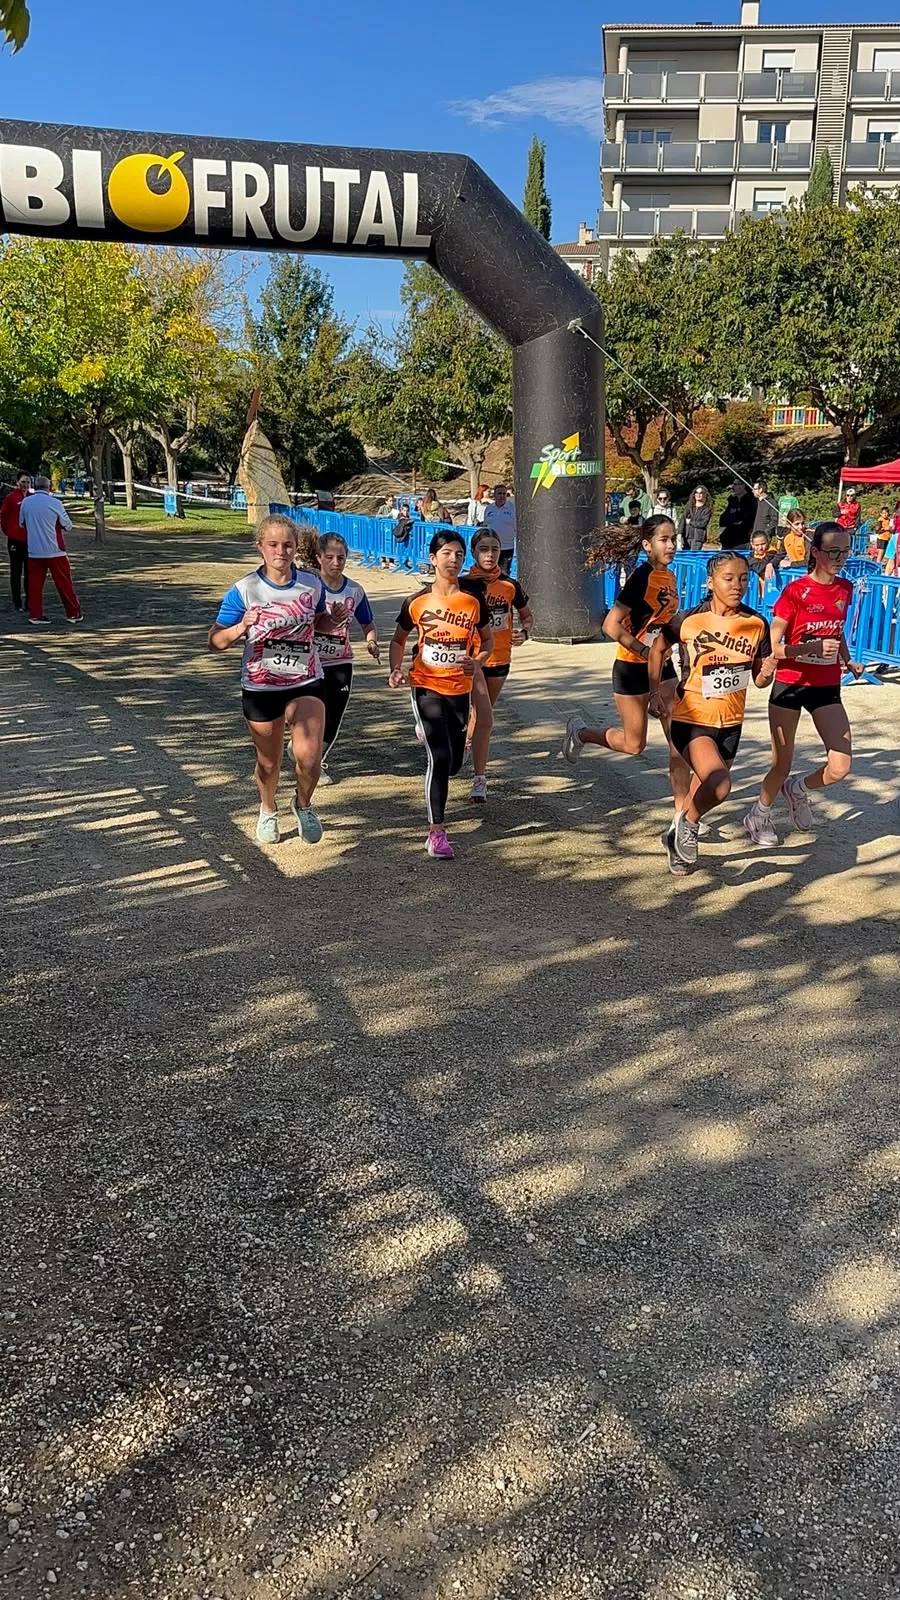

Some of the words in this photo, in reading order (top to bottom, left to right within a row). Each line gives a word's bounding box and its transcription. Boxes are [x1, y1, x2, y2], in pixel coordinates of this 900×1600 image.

[0, 143, 432, 248] BIOFRUTAL
[540, 444, 581, 467] Sport
[552, 462, 602, 476] BIOFRUTAL
[316, 643, 336, 655] 348
[273, 653, 300, 667] 347
[431, 651, 456, 664] 303
[713, 675, 740, 689] 366
